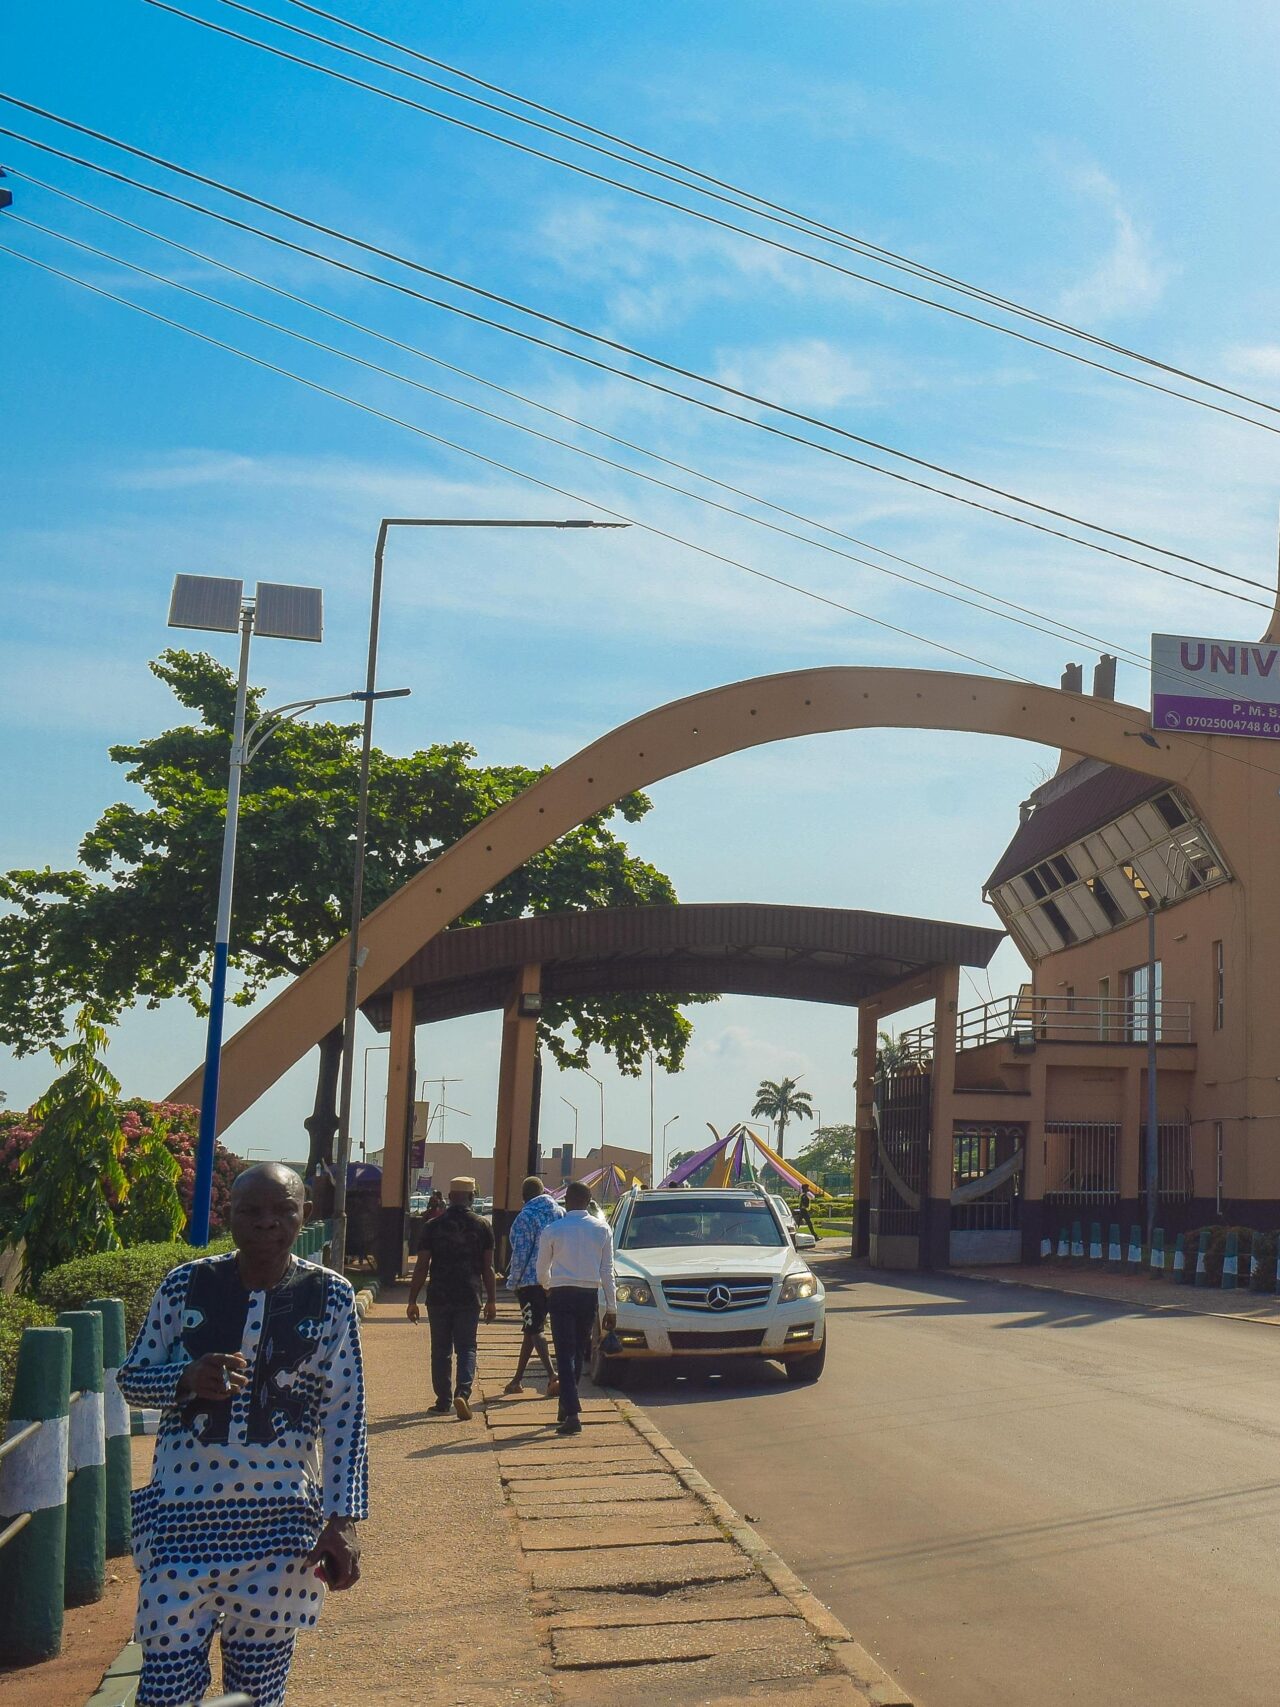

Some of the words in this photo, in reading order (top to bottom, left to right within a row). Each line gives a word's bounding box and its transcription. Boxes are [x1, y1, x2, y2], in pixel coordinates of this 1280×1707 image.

[1232, 704, 1245, 716] P.
[1248, 706, 1266, 717] M.
[1185, 716, 1261, 733] 07025004748
[1263, 723, 1272, 733] &
